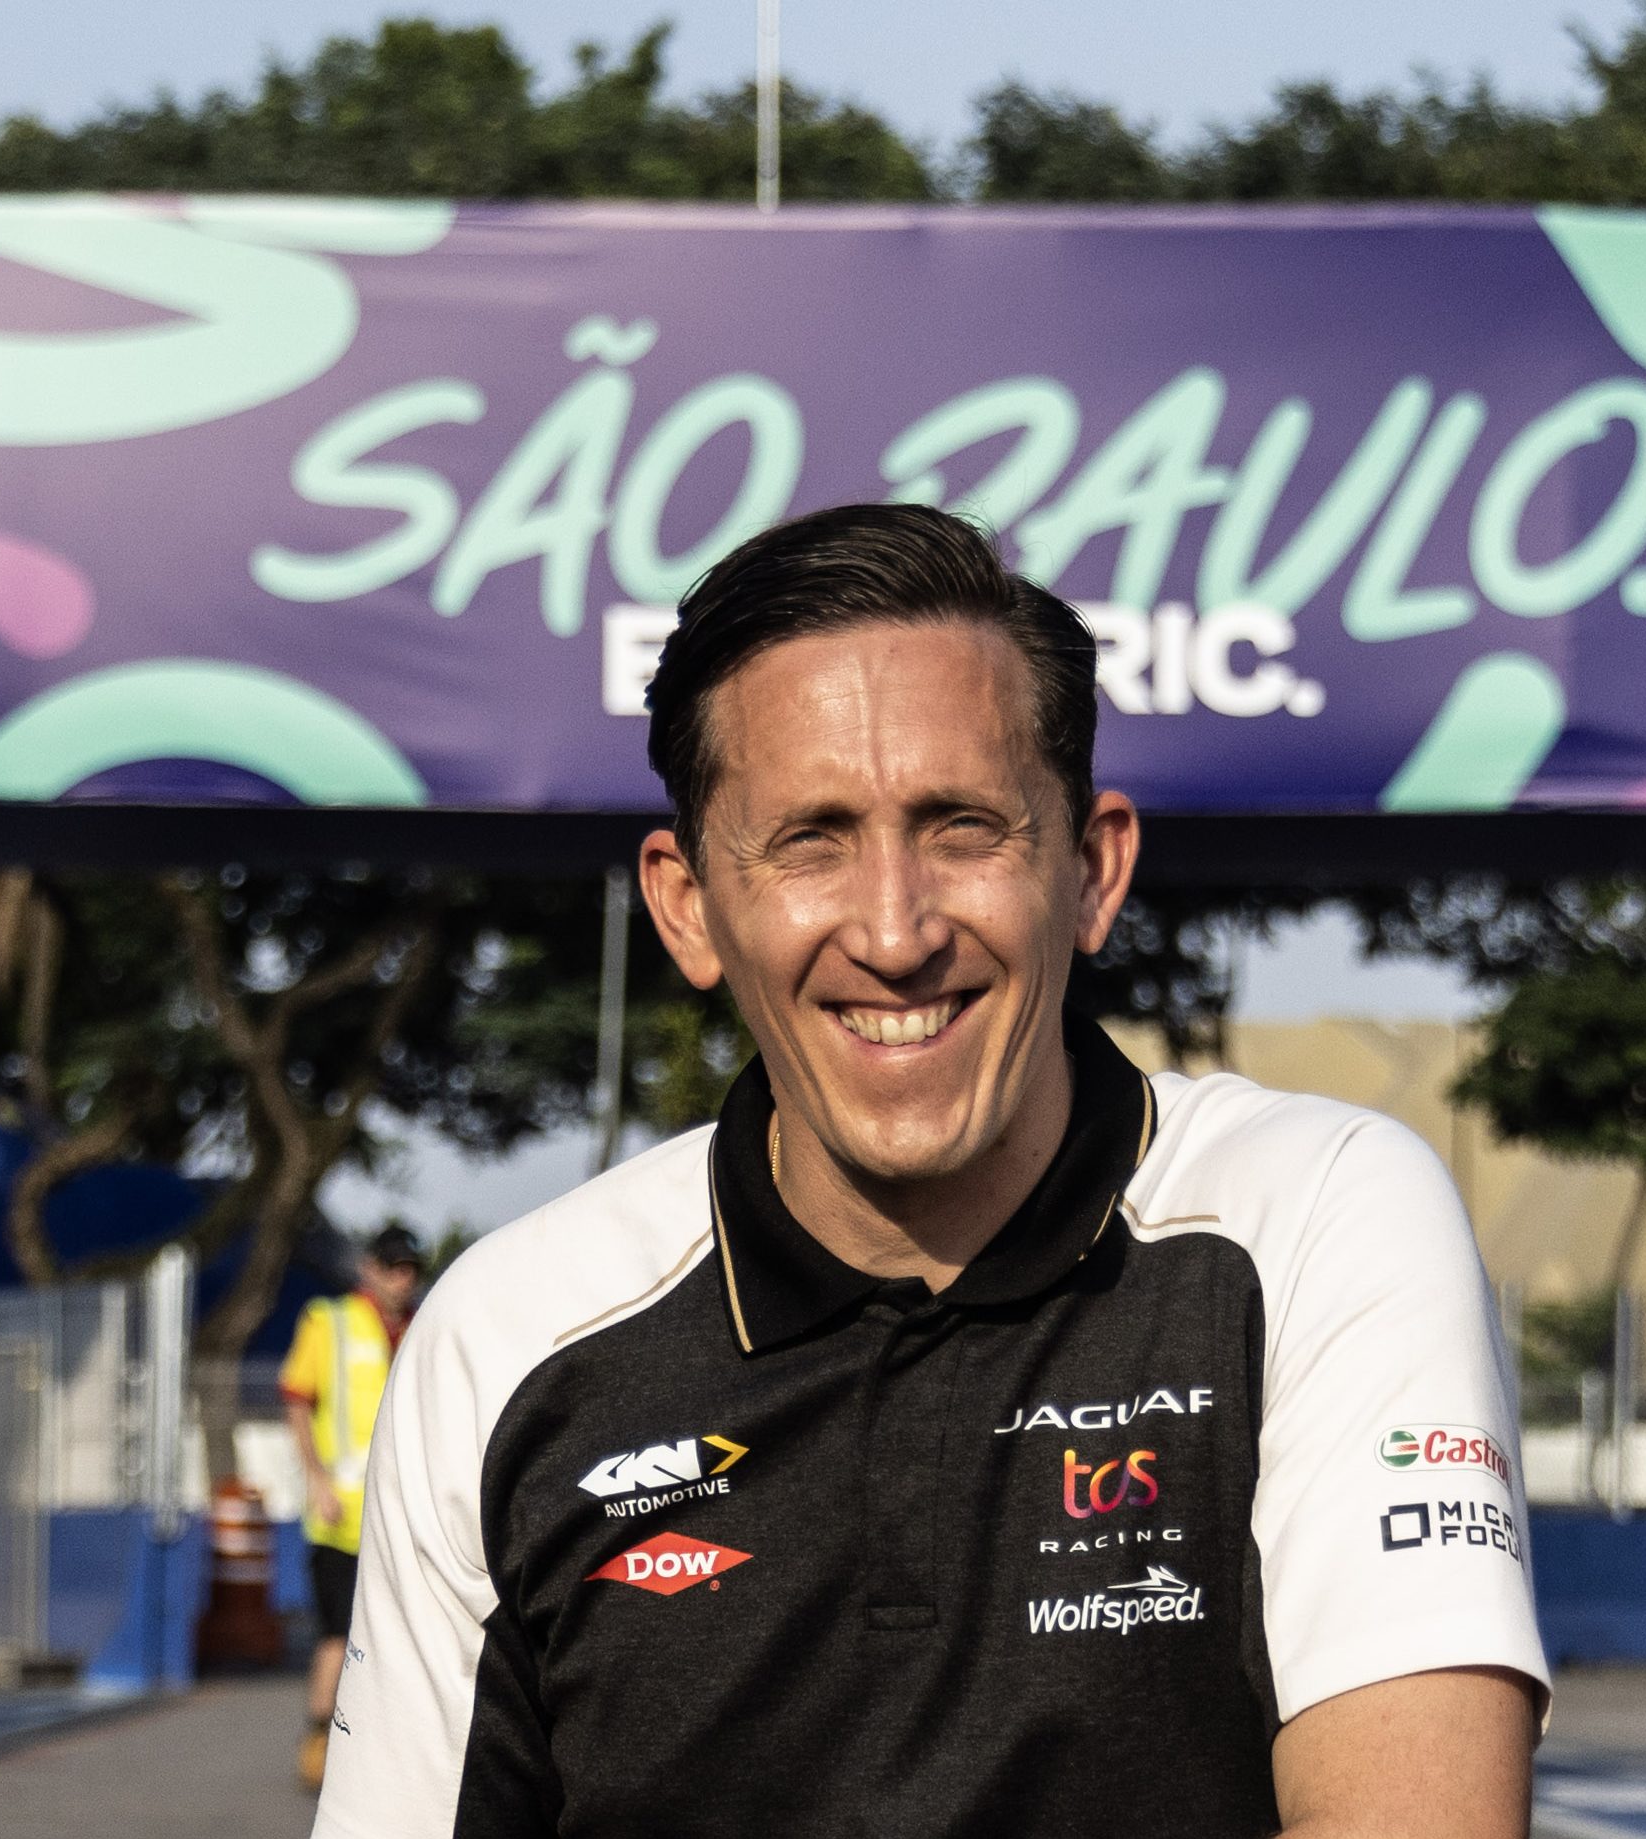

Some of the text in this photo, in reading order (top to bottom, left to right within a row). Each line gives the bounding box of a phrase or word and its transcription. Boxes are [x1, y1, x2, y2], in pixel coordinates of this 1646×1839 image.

[250, 316, 804, 637] SÃO
[601, 602, 1327, 717] ERIC.
[604, 1477, 731, 1518] AUTOMOTIVE
[1063, 1449, 1159, 1519] tcs
[1039, 1528, 1183, 1553] RACING
[1437, 1500, 1522, 1538] MICR
